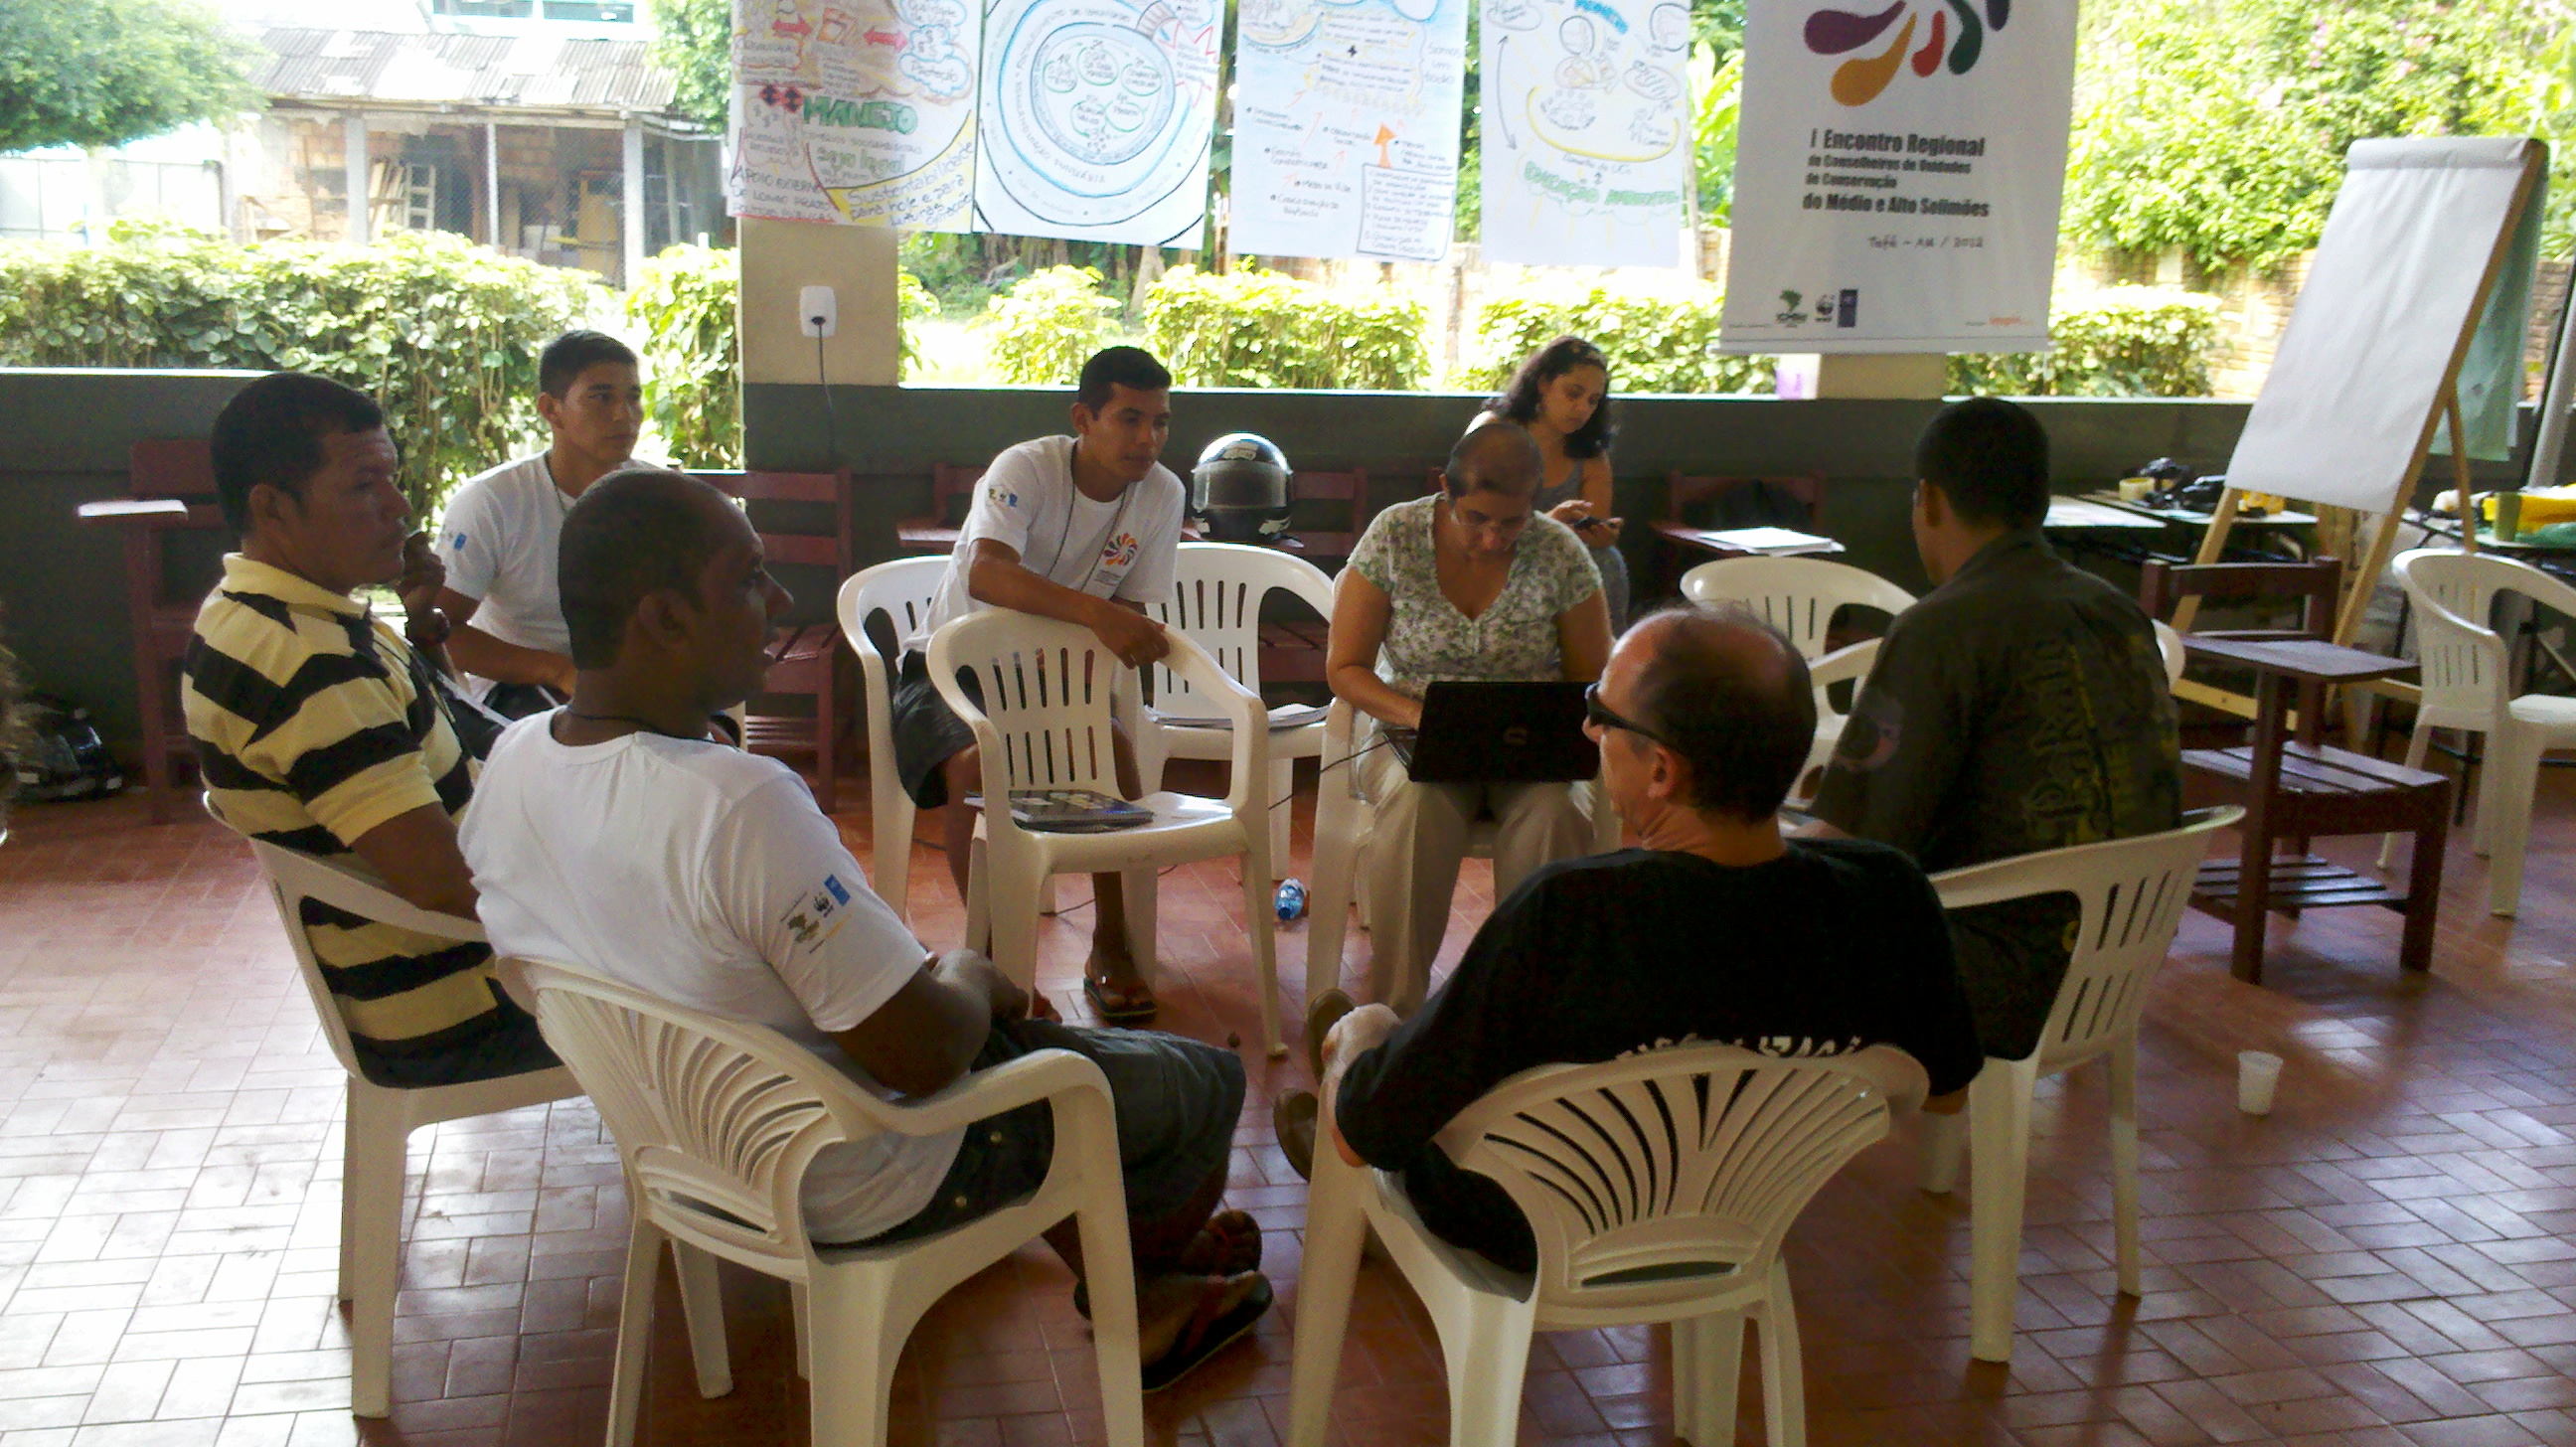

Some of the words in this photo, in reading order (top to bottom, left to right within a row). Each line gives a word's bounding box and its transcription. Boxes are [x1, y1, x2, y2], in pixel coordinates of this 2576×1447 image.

[804, 96, 918, 135] MANEJO
[1811, 128, 1818, 148] I
[1824, 129, 1902, 152] Encontro
[1907, 133, 1986, 156] Regional
[1808, 155, 1821, 167] de
[1902, 159, 1916, 171] de
[1806, 173, 1819, 185] de
[1822, 173, 1897, 188] Conservação
[1826, 194, 1872, 212] Médio
[1875, 198, 1884, 212] e
[1887, 196, 1917, 213] Alto
[1920, 198, 1989, 217] Solimões
[1868, 235, 1897, 250] Tefé
